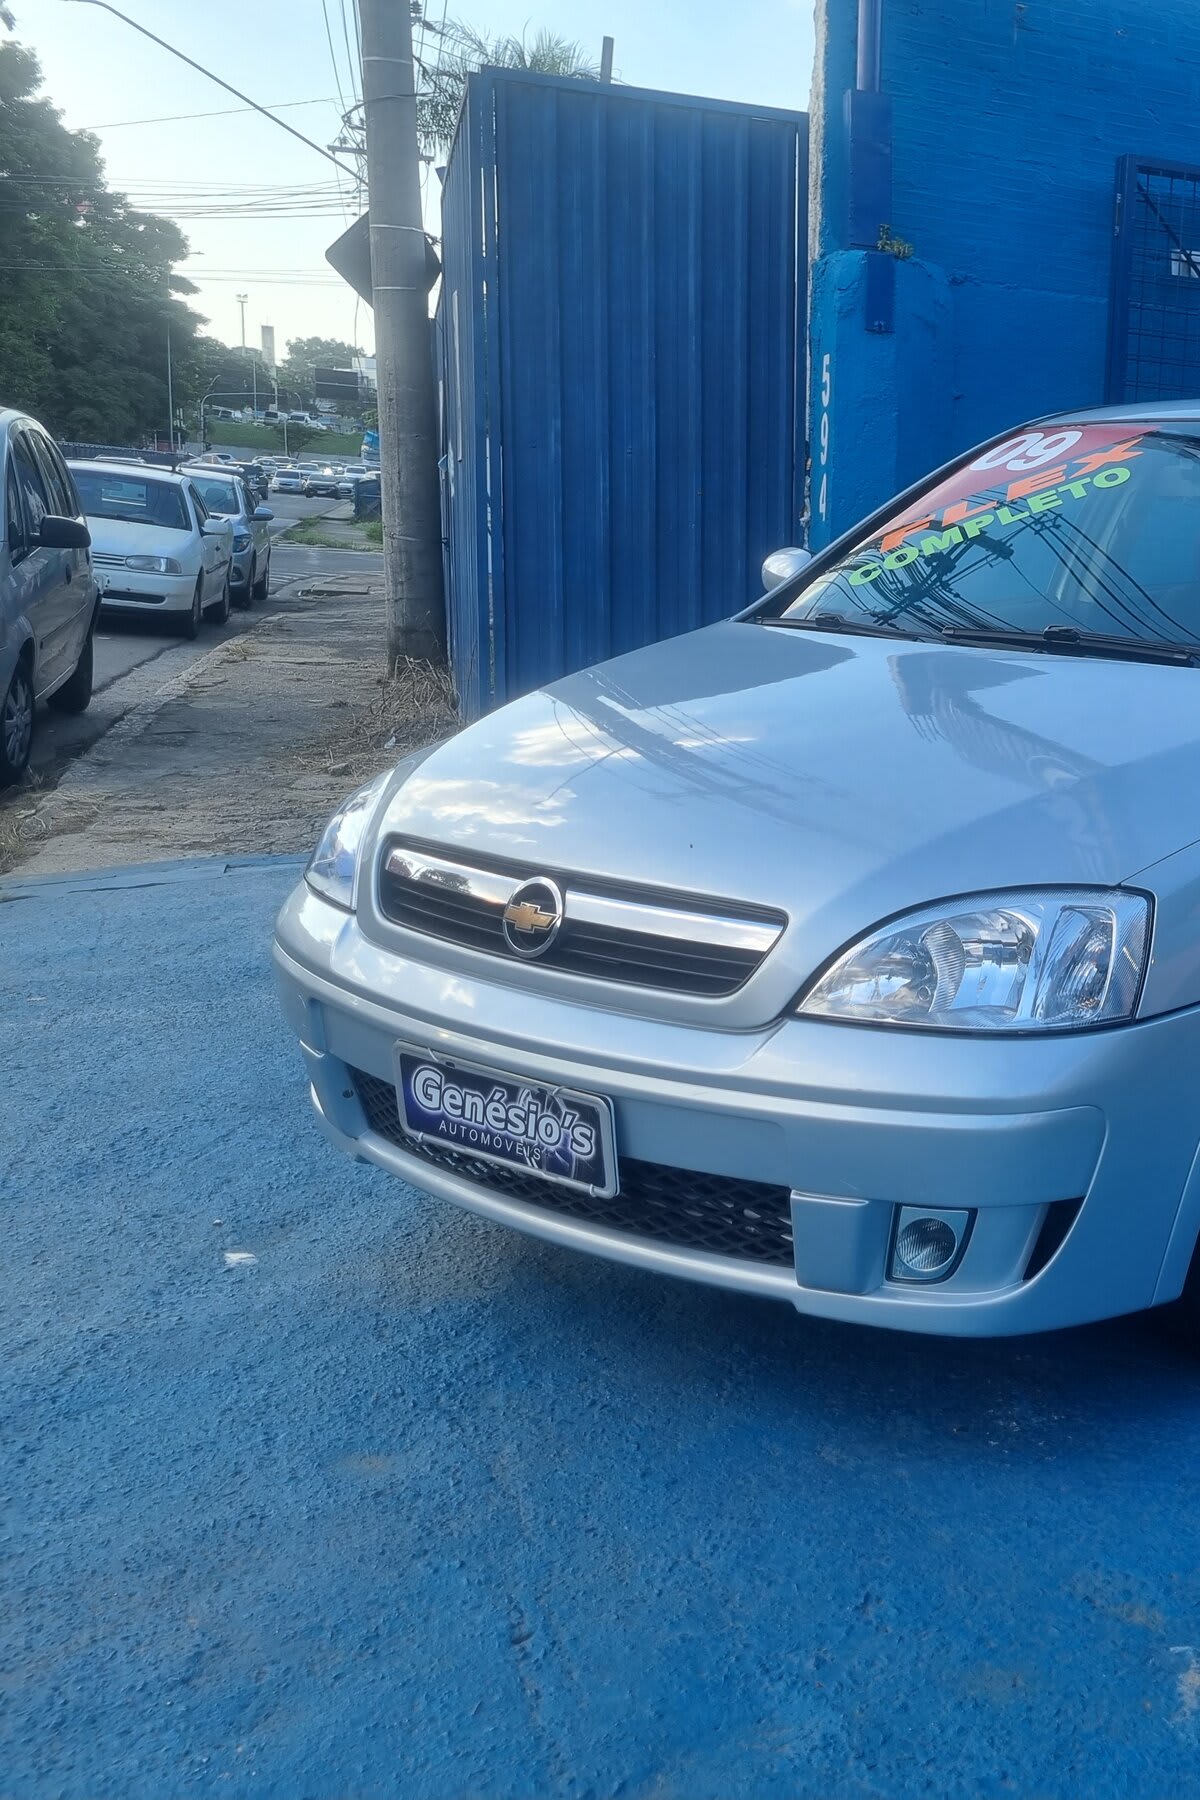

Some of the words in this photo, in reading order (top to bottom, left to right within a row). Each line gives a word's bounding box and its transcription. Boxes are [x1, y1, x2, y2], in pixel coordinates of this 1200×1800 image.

[879, 437, 1145, 555] FLEX
[969, 430, 1084, 472] 09
[848, 467, 1132, 587] COMPLETO
[412, 1066, 595, 1157] Genésio's
[438, 1119, 541, 1161] AUTOMÓVEIS
